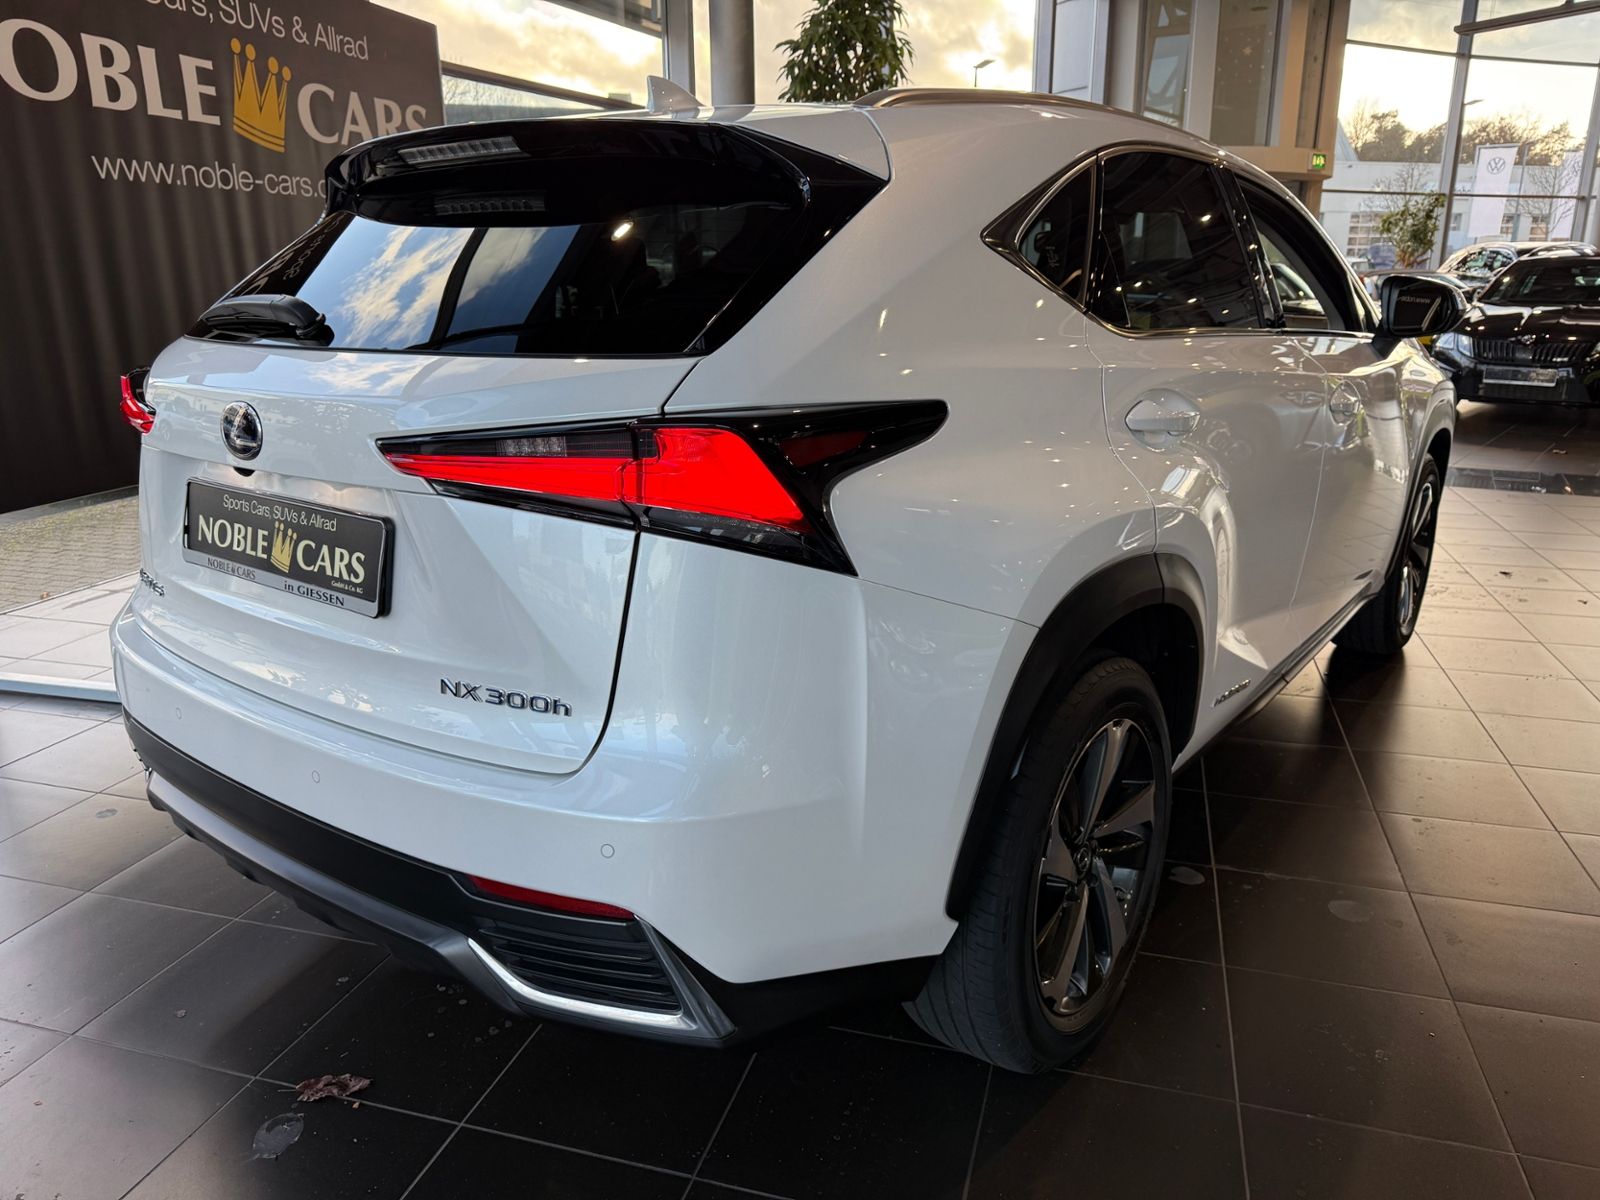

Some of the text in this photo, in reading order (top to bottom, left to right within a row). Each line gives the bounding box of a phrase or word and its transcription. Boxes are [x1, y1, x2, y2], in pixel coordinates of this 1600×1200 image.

[146, 0, 369, 60] ars, SUVs & Allrad
[222, 494, 337, 532] Sports Cars, SUVs & Allrad
[198, 514, 366, 584] NOBLE CARS
[207, 557, 256, 580] NOBLE CARS
[284, 580, 345, 607] in GIESSEN
